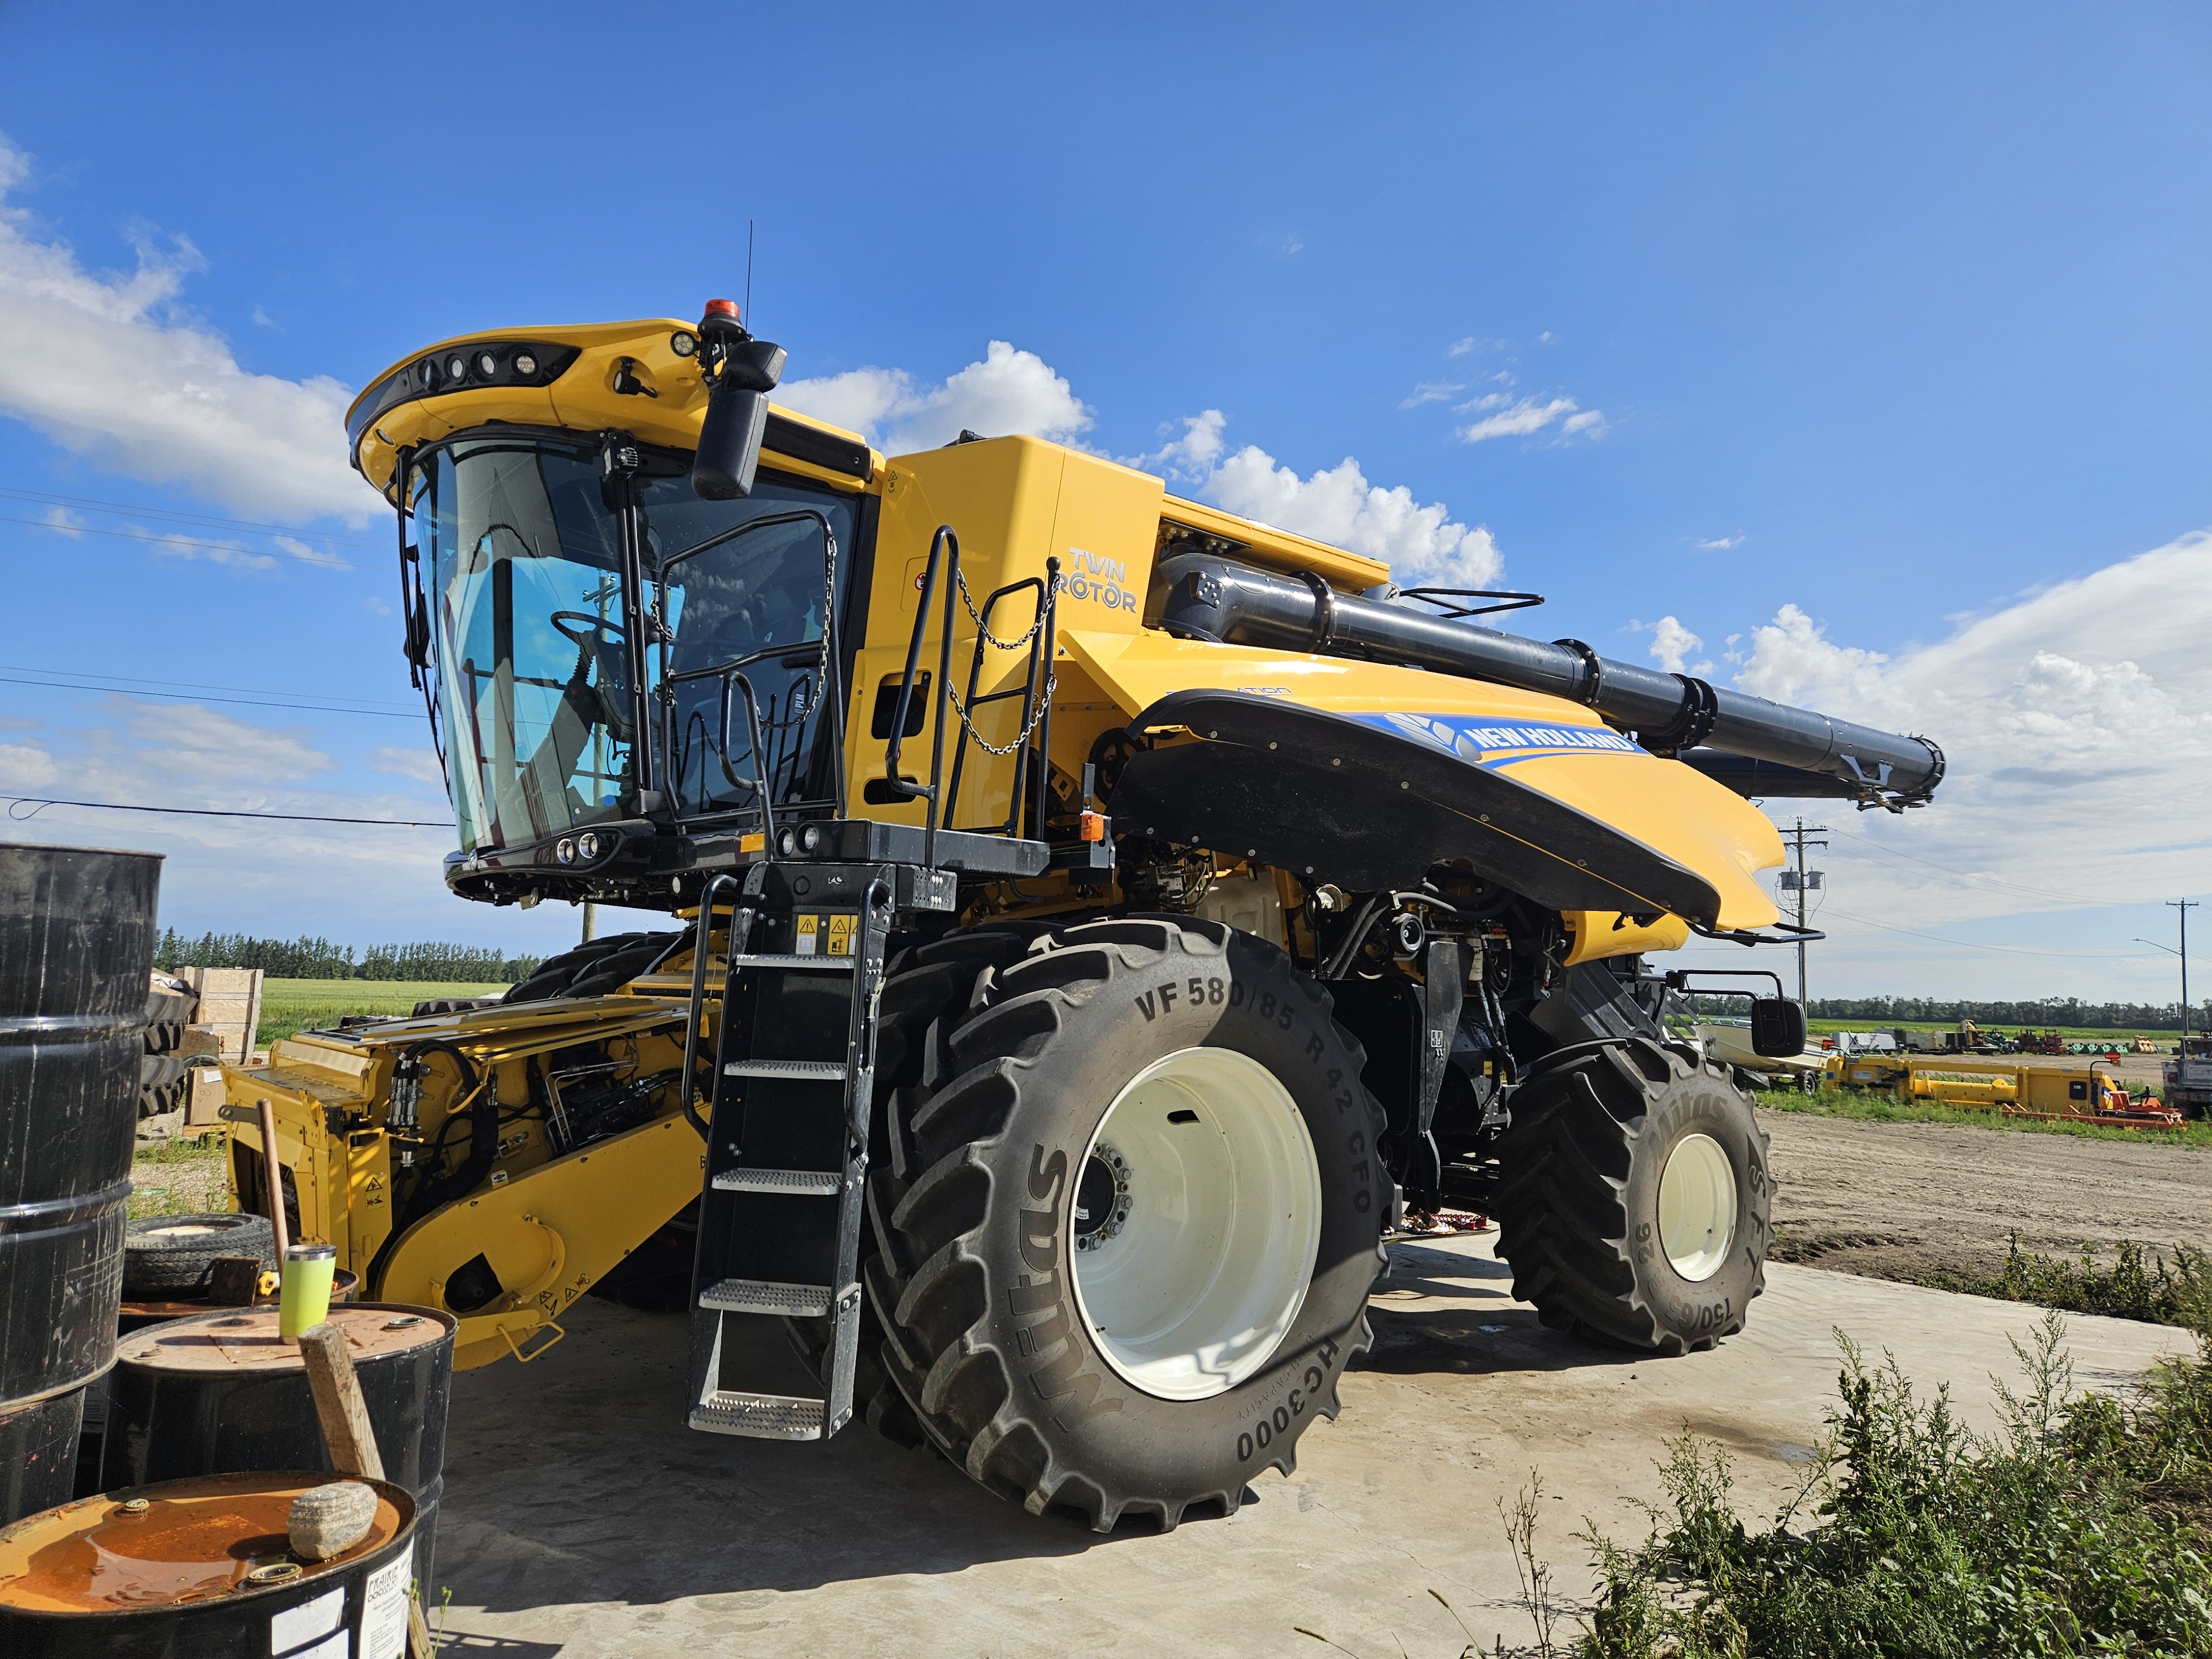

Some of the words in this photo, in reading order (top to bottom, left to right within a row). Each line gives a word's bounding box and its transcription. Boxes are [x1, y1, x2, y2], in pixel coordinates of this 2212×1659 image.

[1070, 547, 1125, 582] TWIN
[1057, 571, 1136, 613] ROTOR
[795, 693, 805, 708] PLM
[1463, 727, 1529, 748] NEW
[1517, 727, 1635, 751] HOLLAND
[1134, 982, 1177, 1022] VF
[1188, 977, 1295, 1031] 580/85
[1305, 1031, 1325, 1064] R
[1327, 1067, 1354, 1115] 42
[1648, 1091, 1728, 1179] Mitas
[1635, 1222, 1655, 1265] 26
[1009, 1142, 1124, 1433] Mitas
[1665, 1296, 1734, 1330] 750/65
[368, 1566, 399, 1594] PRAIRIE
